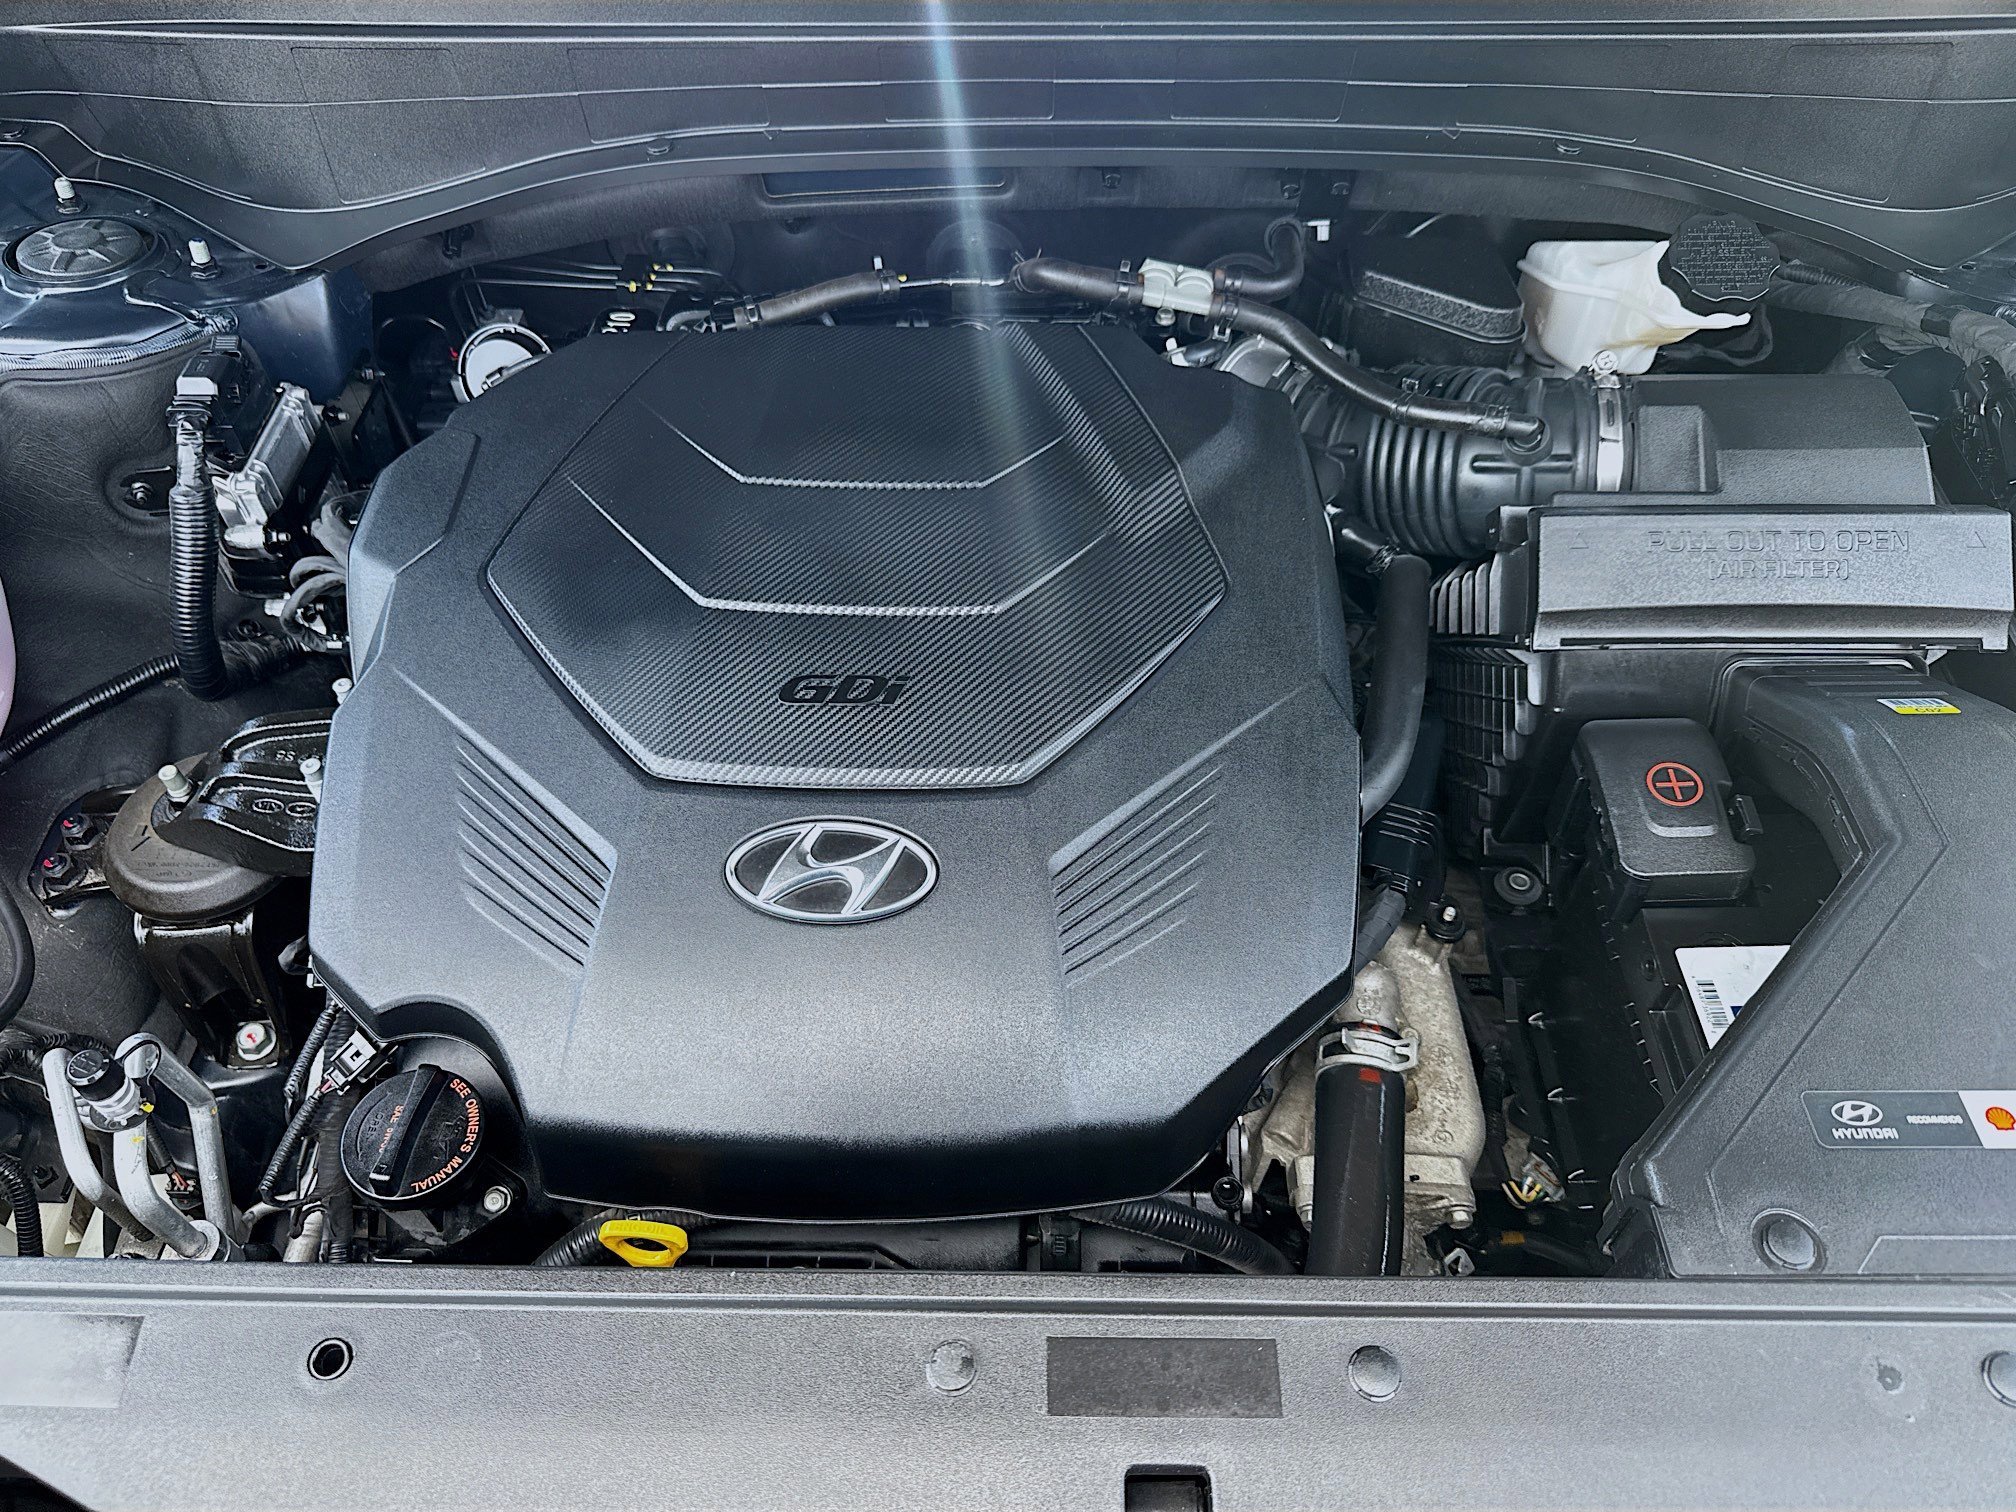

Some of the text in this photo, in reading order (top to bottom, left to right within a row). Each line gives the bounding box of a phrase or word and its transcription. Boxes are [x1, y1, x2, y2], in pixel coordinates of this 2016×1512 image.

[1647, 530, 1910, 552] PULL OUT TO OPEN
[390, 1104, 404, 1123] SAE
[411, 1078, 480, 1192] SEE OWNER'S MANUAL
[1831, 1127, 1899, 1140] HYUNDAI
